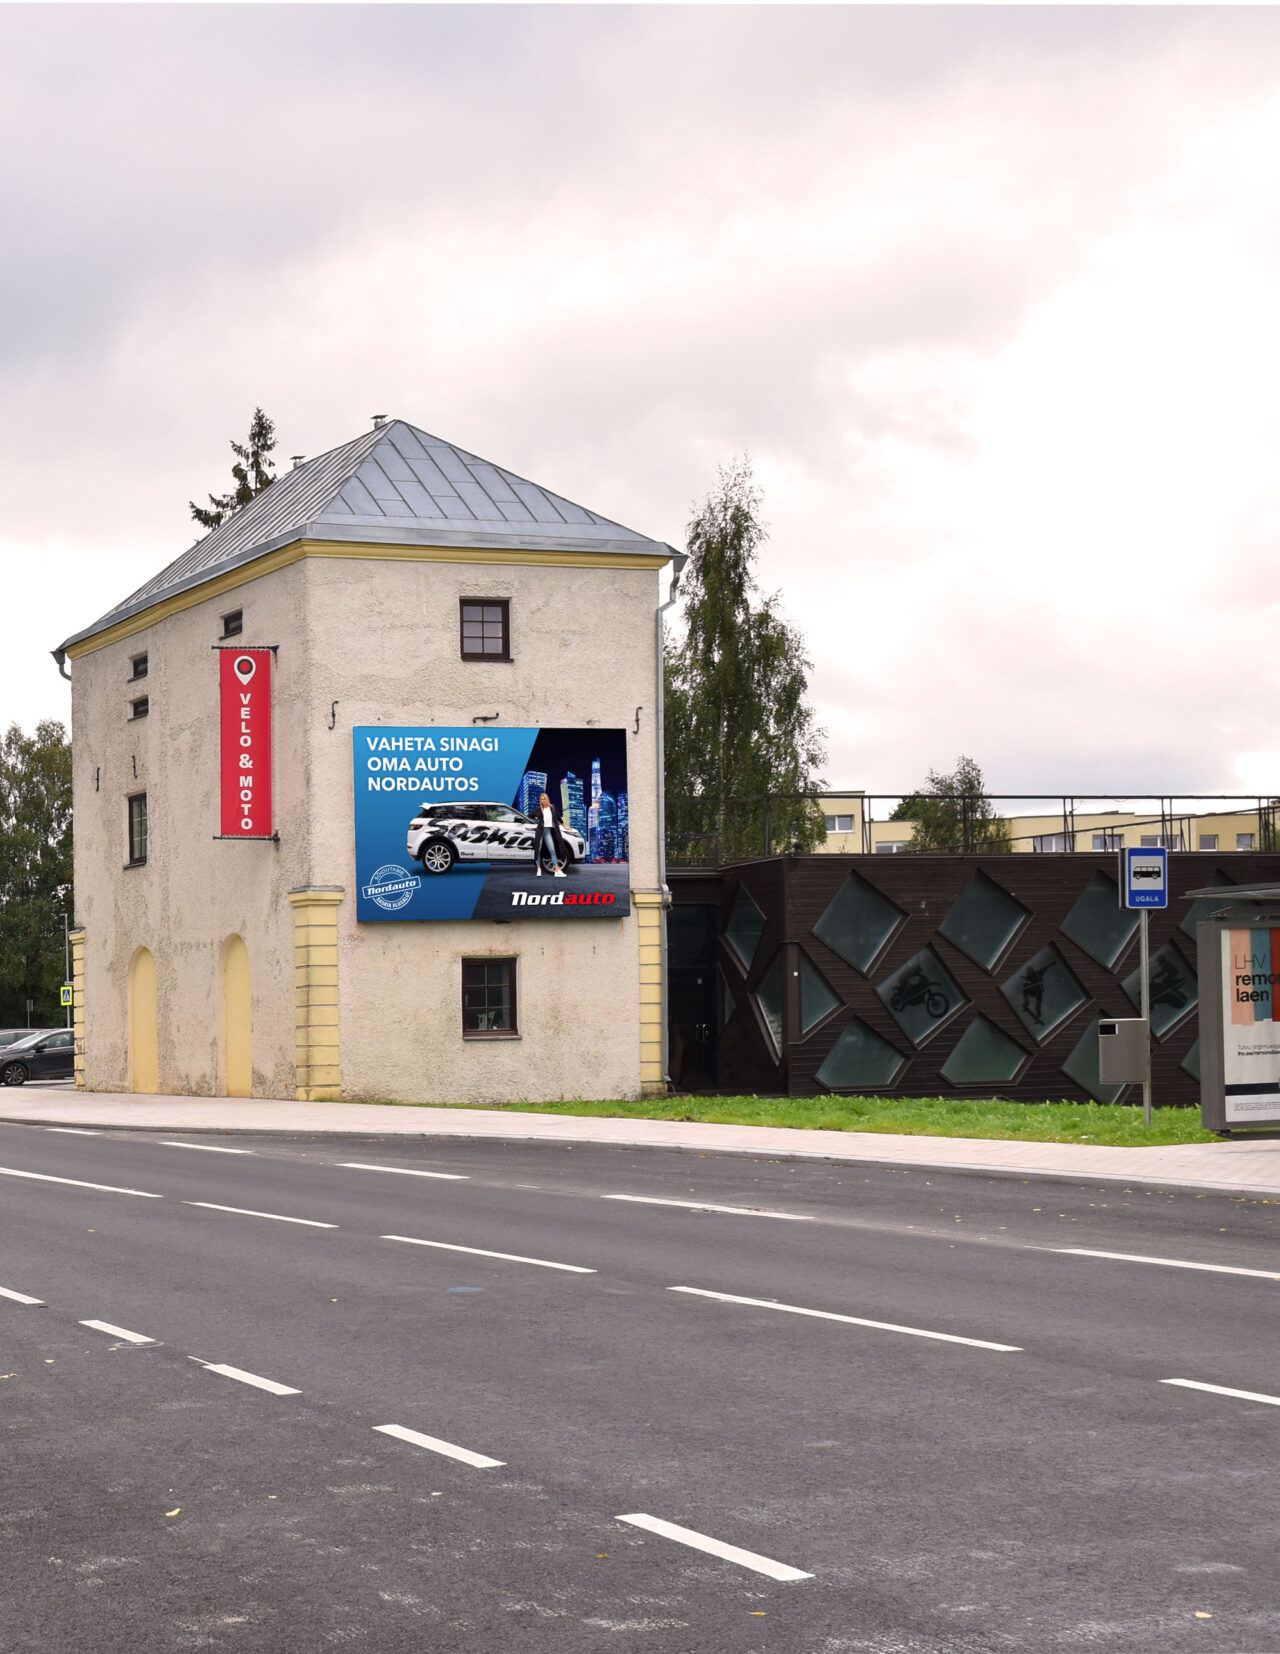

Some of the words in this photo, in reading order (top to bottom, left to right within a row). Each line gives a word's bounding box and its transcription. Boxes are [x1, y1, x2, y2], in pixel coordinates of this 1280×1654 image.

[239, 693, 252, 747] VELO
[366, 737, 436, 751] VAHETA
[440, 737, 499, 751] SINAGI
[239, 753, 253, 769] &
[367, 757, 411, 771] OMA
[414, 757, 463, 771] AUTO
[368, 777, 479, 791] NORDAUTOS
[239, 775, 253, 830] MOTO
[367, 880, 416, 896] Nordauto
[511, 891, 616, 906] Nordauto
[1235, 953, 1266, 969] LHV
[1236, 988, 1269, 1003] laen
